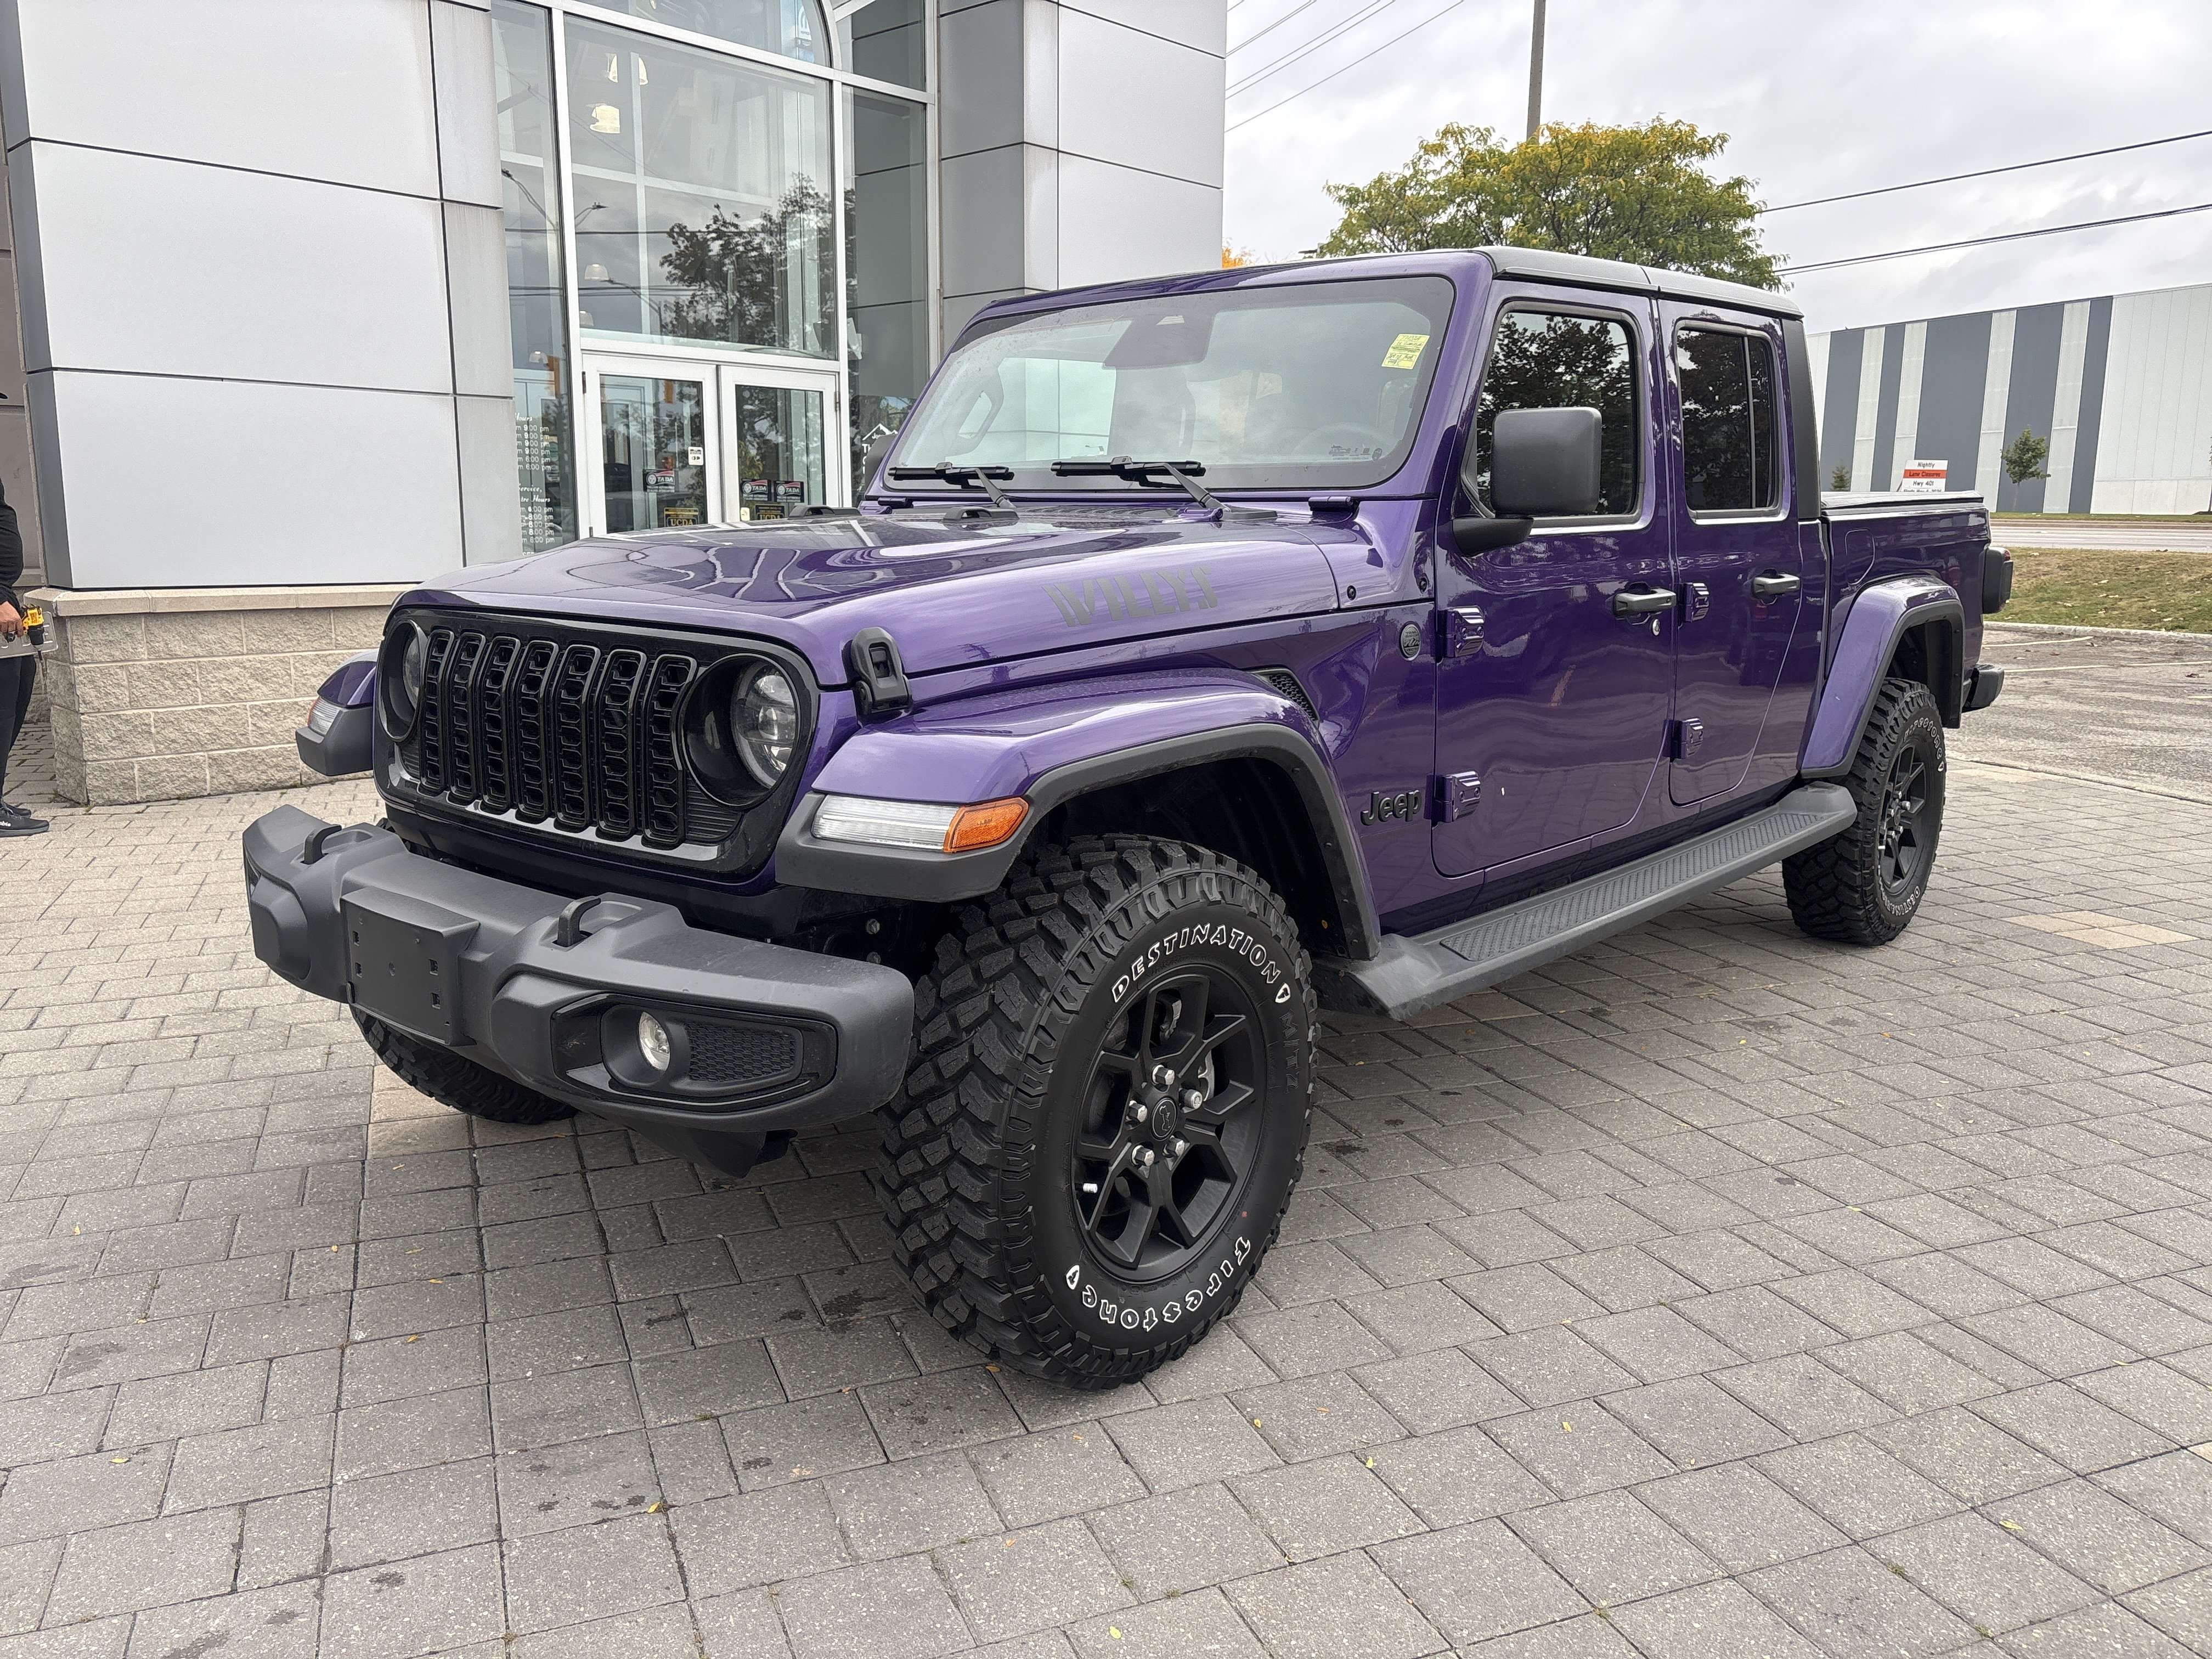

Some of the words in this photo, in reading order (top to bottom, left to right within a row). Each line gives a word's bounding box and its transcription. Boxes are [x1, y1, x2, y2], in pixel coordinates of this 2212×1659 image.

[1042, 567, 1218, 628] WILLYS
[1903, 717, 1943, 760] Firestone
[1361, 790, 1422, 826] Jeep
[1111, 923, 1282, 1003] DESTINATION
[1082, 1236, 1251, 1332] Firestone
